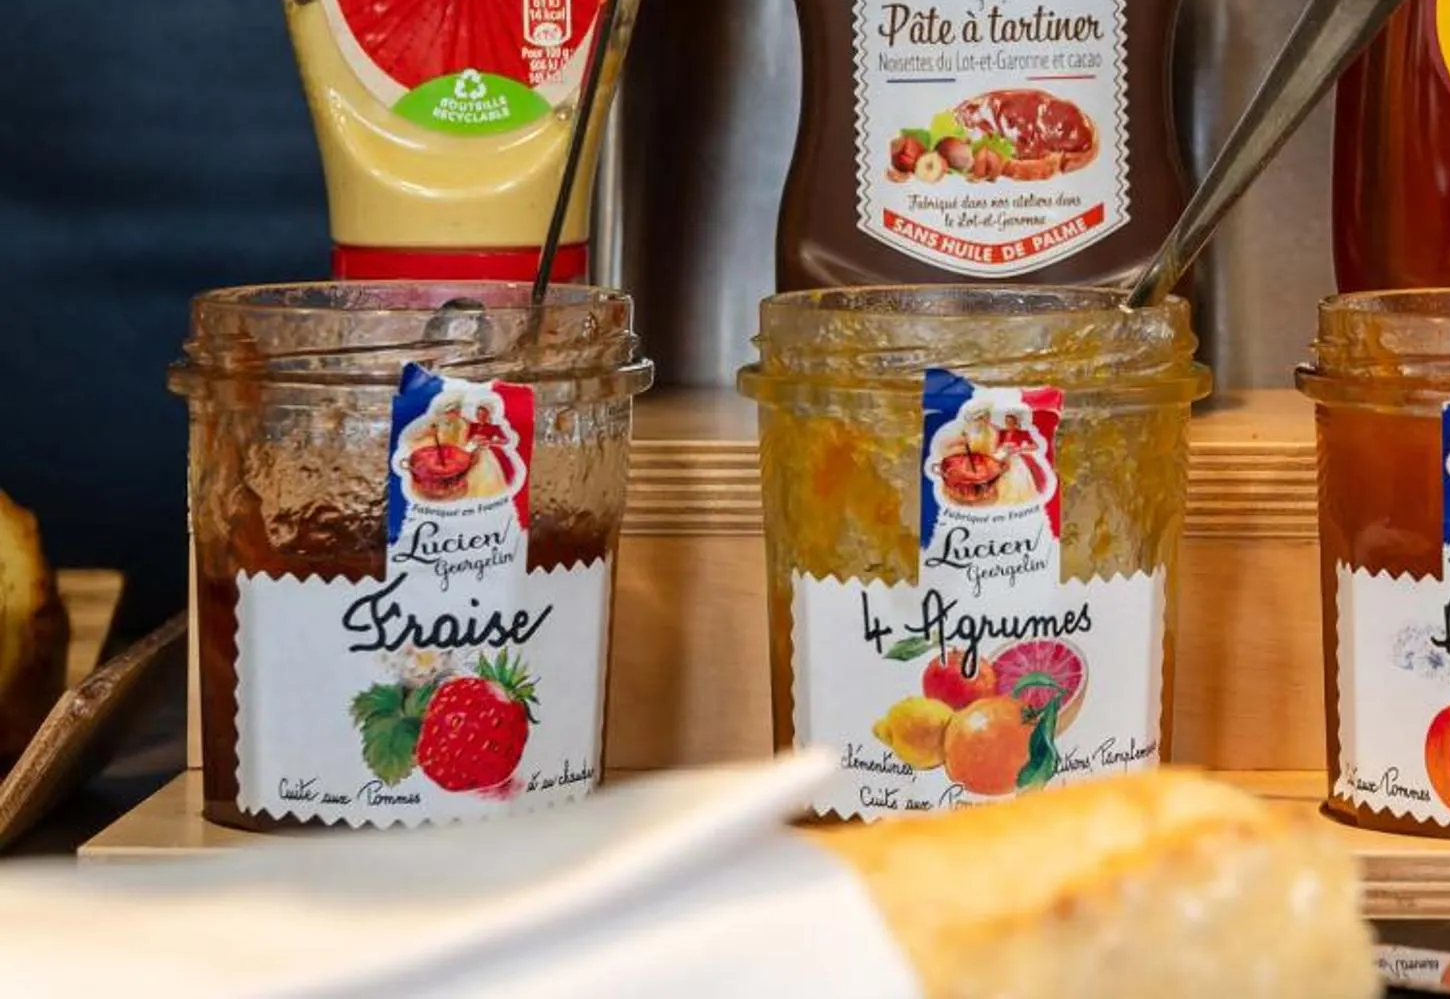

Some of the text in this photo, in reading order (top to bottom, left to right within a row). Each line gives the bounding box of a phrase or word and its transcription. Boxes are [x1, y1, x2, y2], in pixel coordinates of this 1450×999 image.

[878, 3, 1104, 47] Pâte à tartiner
[879, 49, 1103, 72] Noisettes du Lot-et-Garonne et cacao
[893, 217, 1087, 262] SANS HUILE DE PALME
[392, 520, 513, 564] Lucien
[925, 527, 1043, 568] Lucien
[434, 547, 516, 592] Georgelin
[967, 554, 1049, 597] Georgelin
[343, 572, 553, 652] Fraise
[861, 591, 1093, 679] 4 Agrumes
[357, 780, 420, 806] Pommes
[1380, 766, 1431, 801] Pommes
